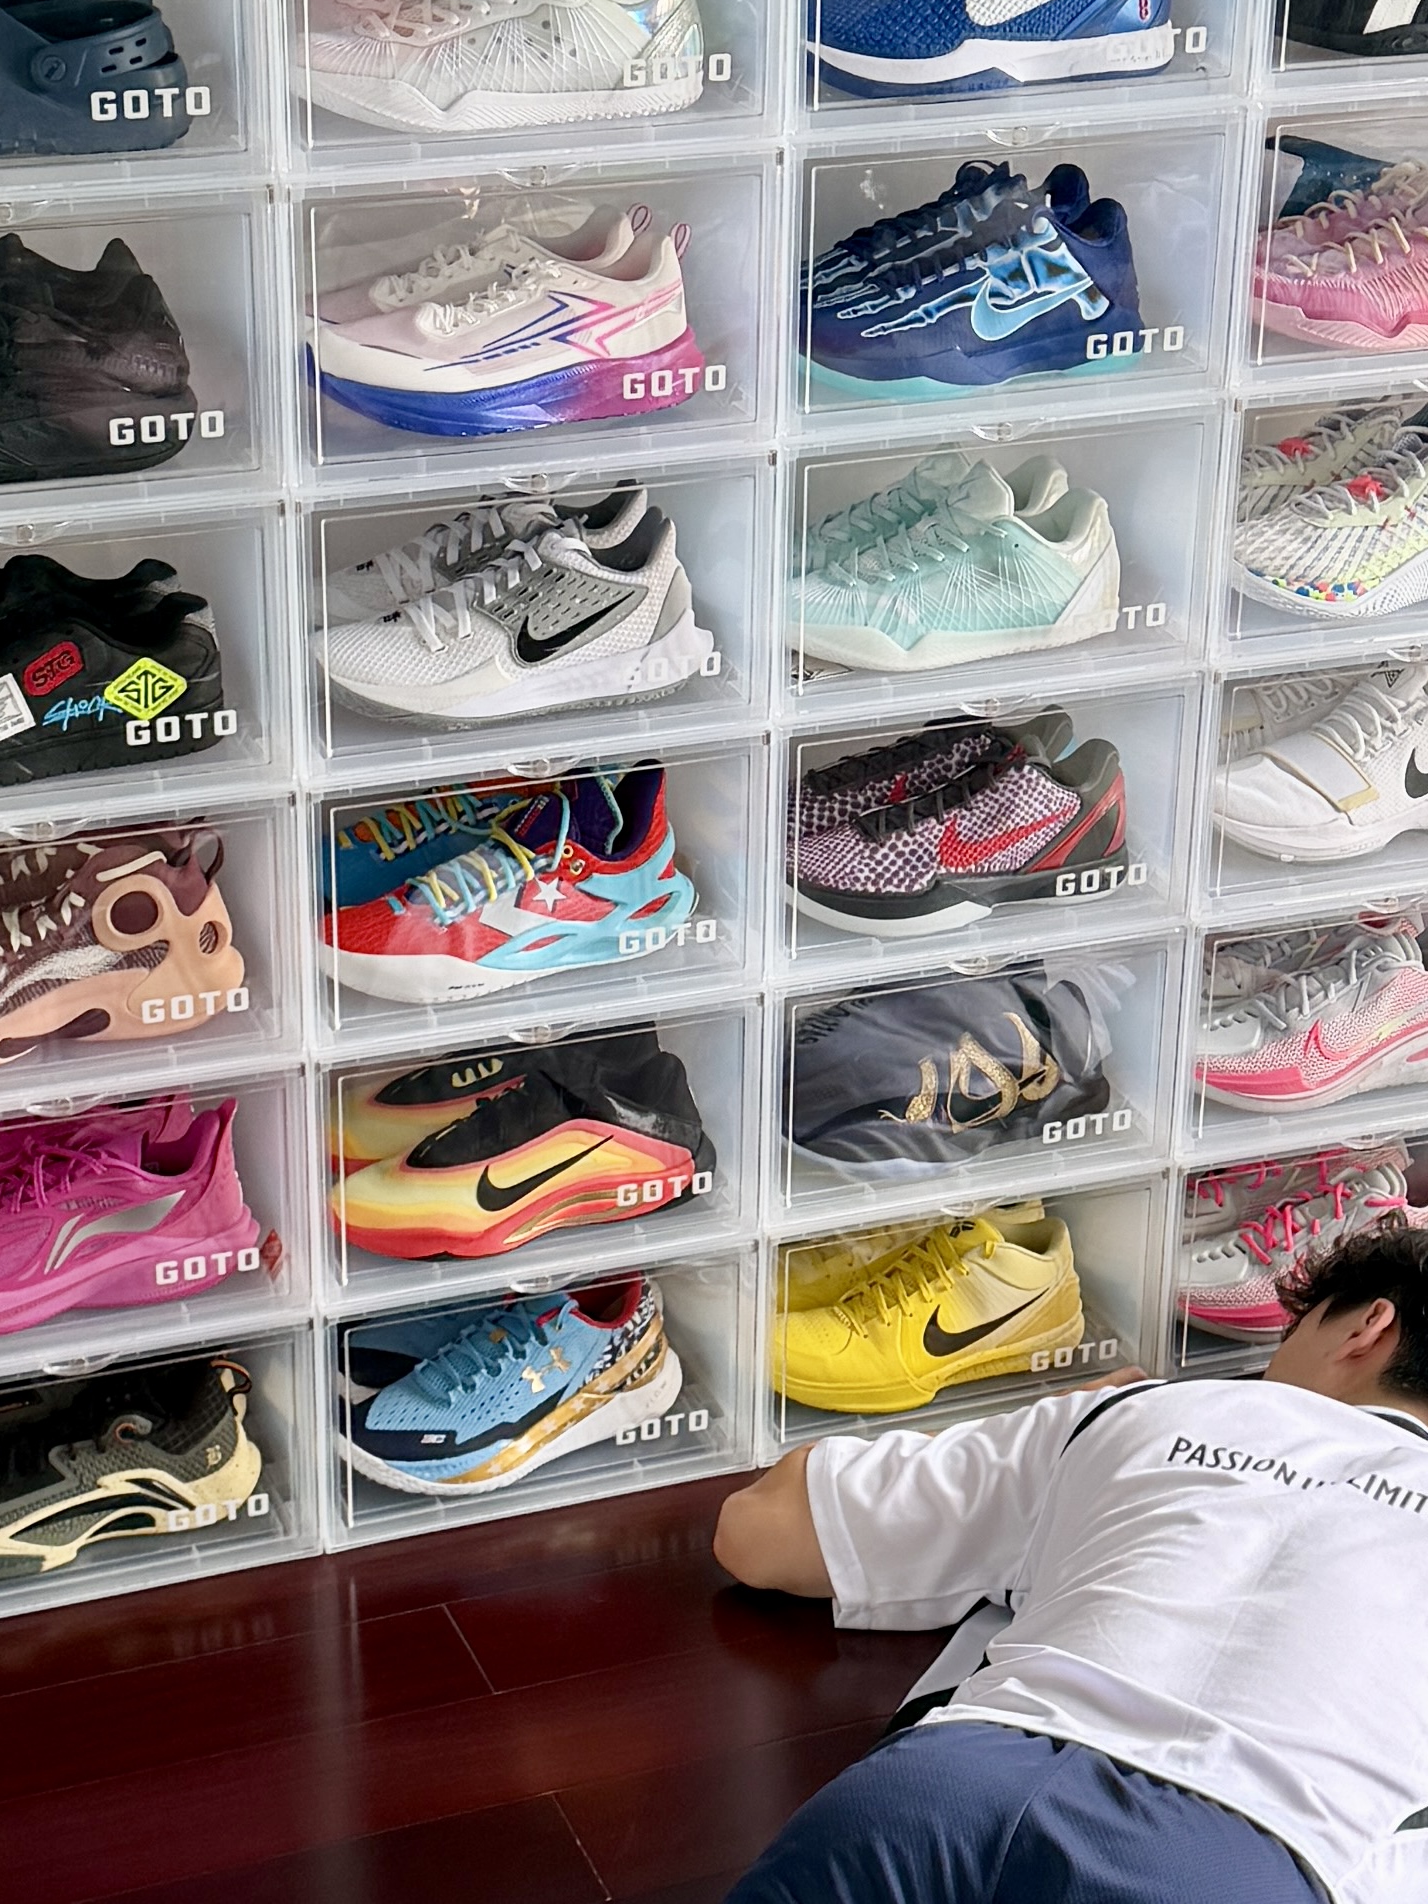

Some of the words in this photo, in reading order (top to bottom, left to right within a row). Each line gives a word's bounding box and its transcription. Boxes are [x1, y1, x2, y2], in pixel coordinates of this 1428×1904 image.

[621, 53, 731, 89] GOTO
[90, 87, 211, 121] GOTO
[1086, 326, 1185, 359] GOTO
[622, 366, 727, 399] GOTO
[109, 410, 225, 446] GOTO
[32, 652, 76, 688] STG
[117, 669, 175, 709] STG
[125, 711, 238, 746] GOTO
[1055, 863, 1147, 896] GOTO
[618, 920, 717, 955] GOTO
[141, 987, 249, 1023] GOTO
[1042, 1110, 1132, 1143] GOTO
[617, 1170, 713, 1207] GOTO
[156, 1249, 260, 1285] GOTO
[1031, 1339, 1118, 1371] GOTO
[615, 1410, 709, 1446] GOTO
[1167, 1437, 1296, 1489] PASSION
[167, 1494, 270, 1532] GOTO
